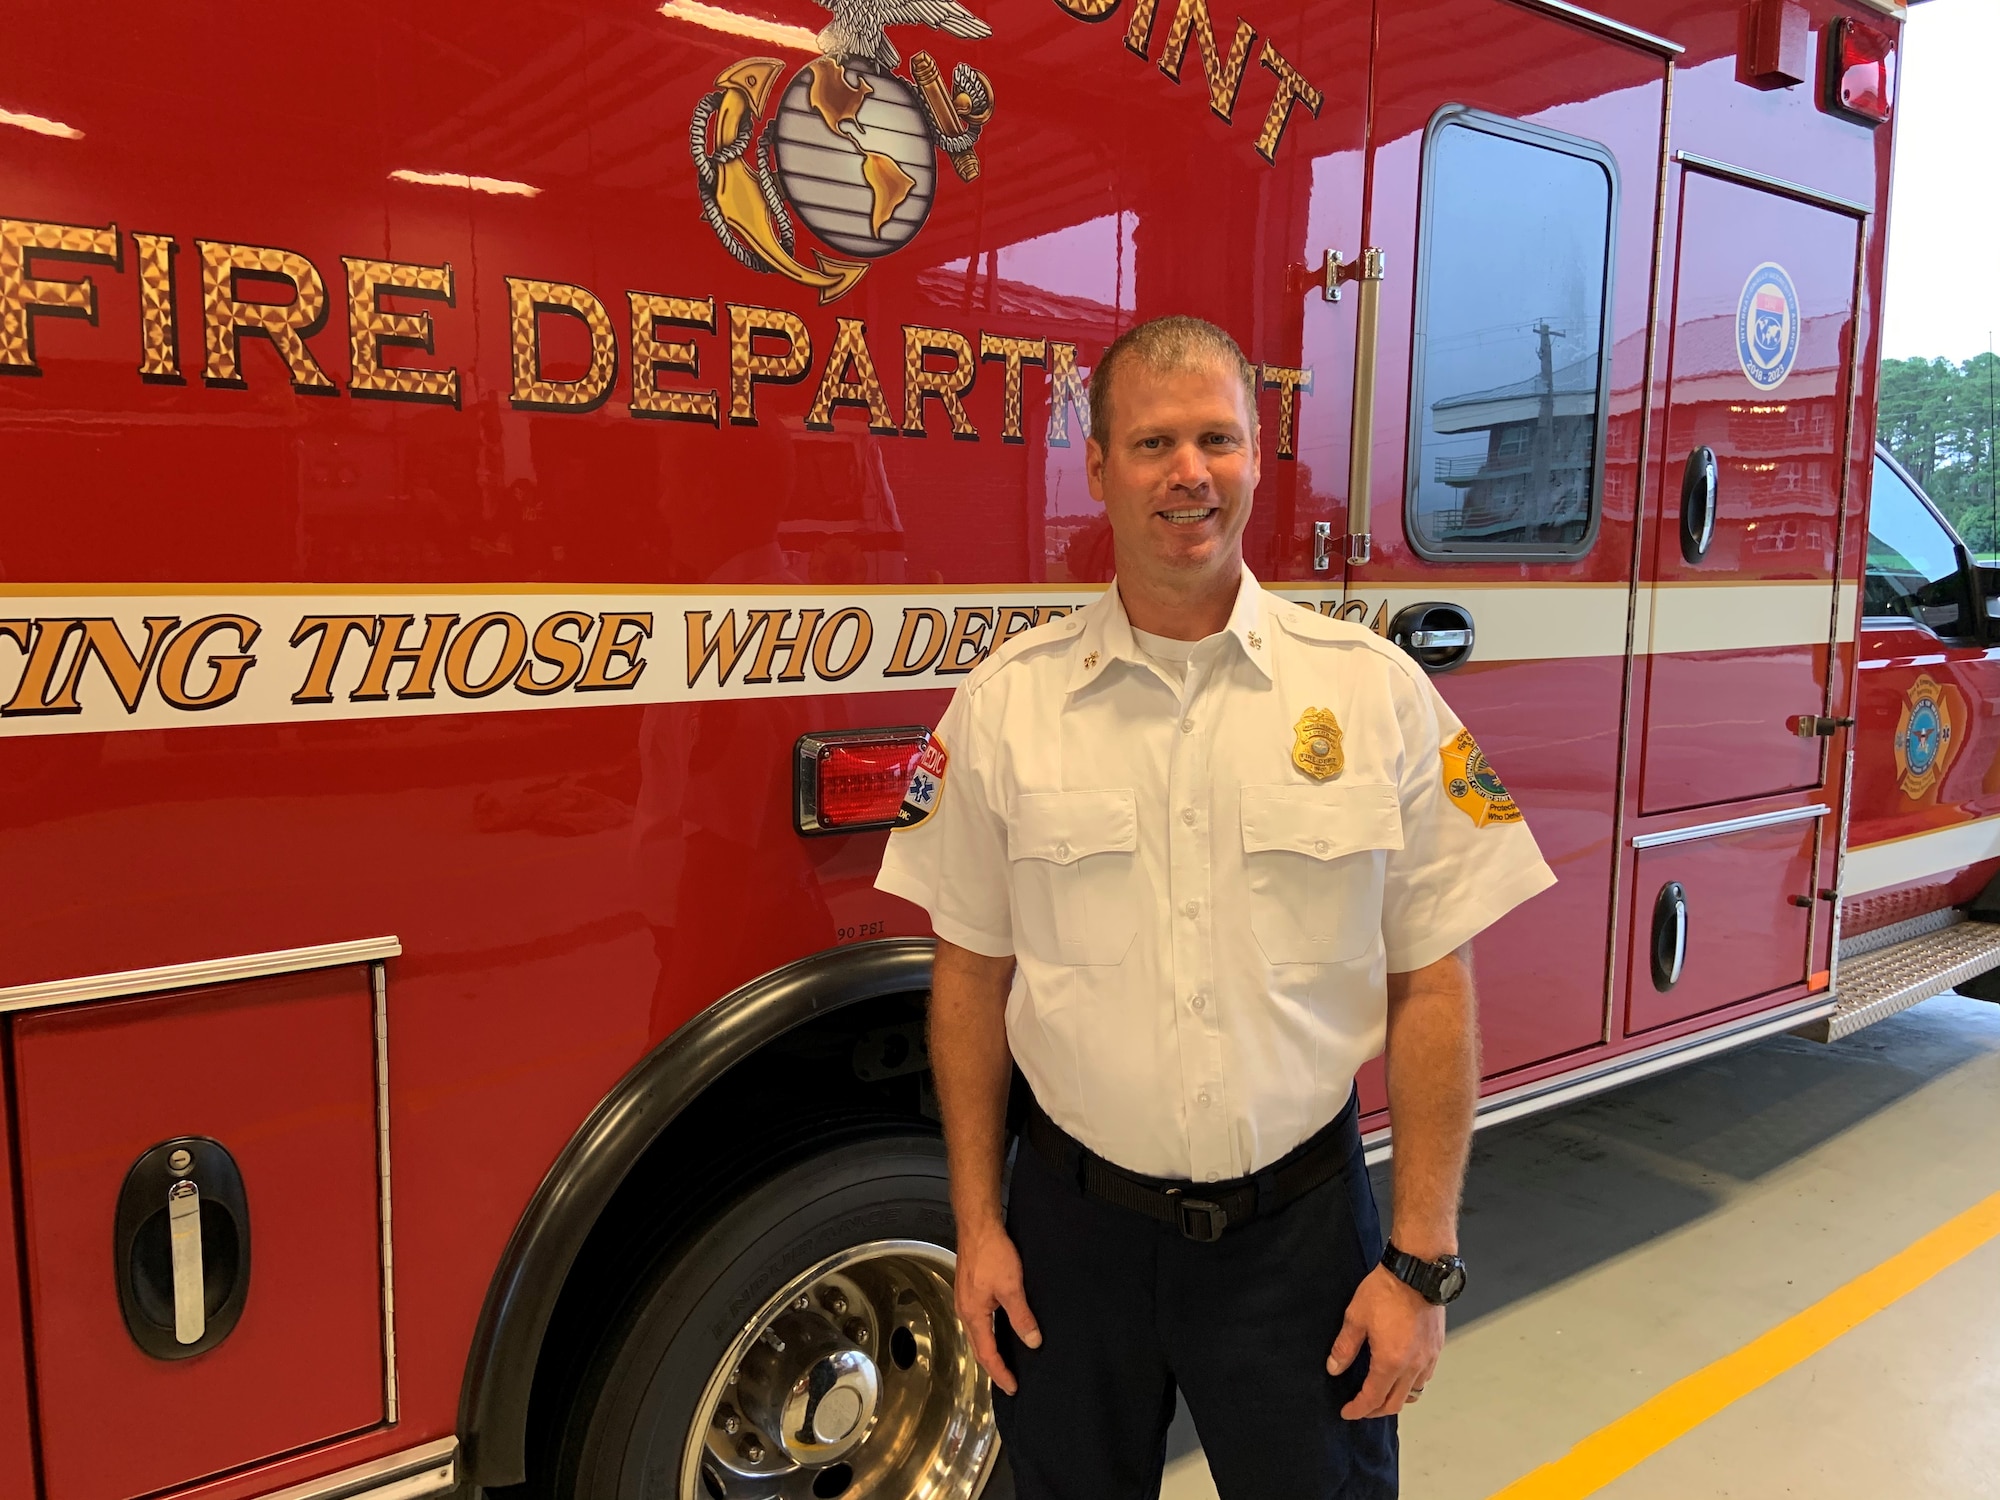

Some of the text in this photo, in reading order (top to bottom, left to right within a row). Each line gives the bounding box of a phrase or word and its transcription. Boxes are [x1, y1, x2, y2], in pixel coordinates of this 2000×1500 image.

[0, 217, 462, 411] FIRE
[1746, 359, 1762, 381] 2018
[1767, 364, 1784, 382] 2023
[289, 610, 653, 705] THOSE
[684, 607, 873, 688] WHO
[837, 921, 885, 941] 90 PSI
